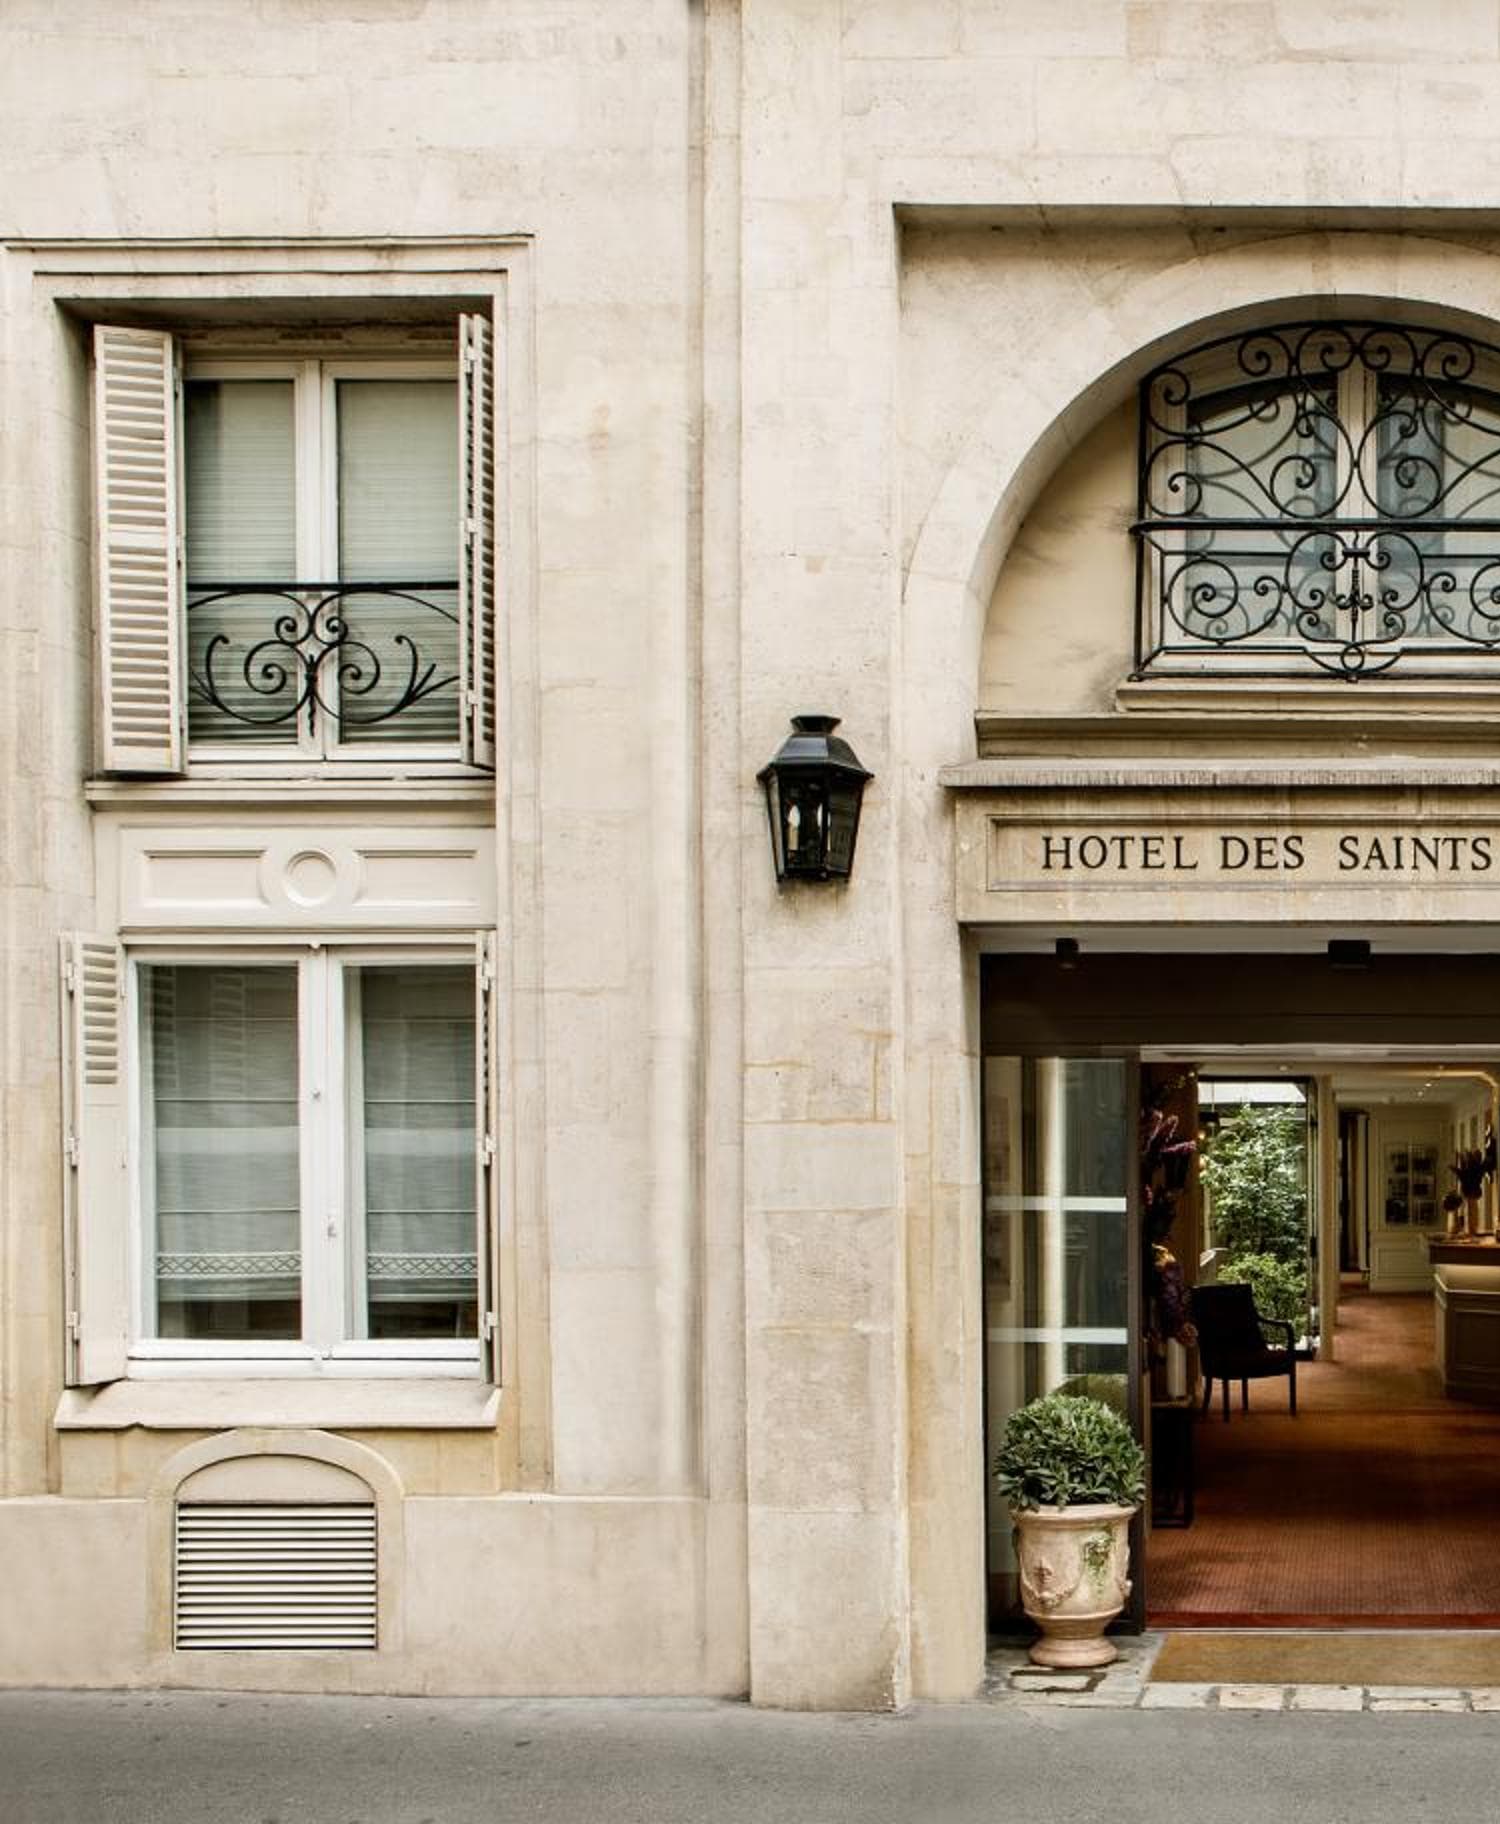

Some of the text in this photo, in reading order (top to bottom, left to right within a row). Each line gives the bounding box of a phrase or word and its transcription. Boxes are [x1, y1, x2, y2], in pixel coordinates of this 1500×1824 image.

[1042, 835, 1198, 870] HOTEL
[1220, 835, 1305, 870] DES
[1339, 835, 1493, 871] SAINTS
